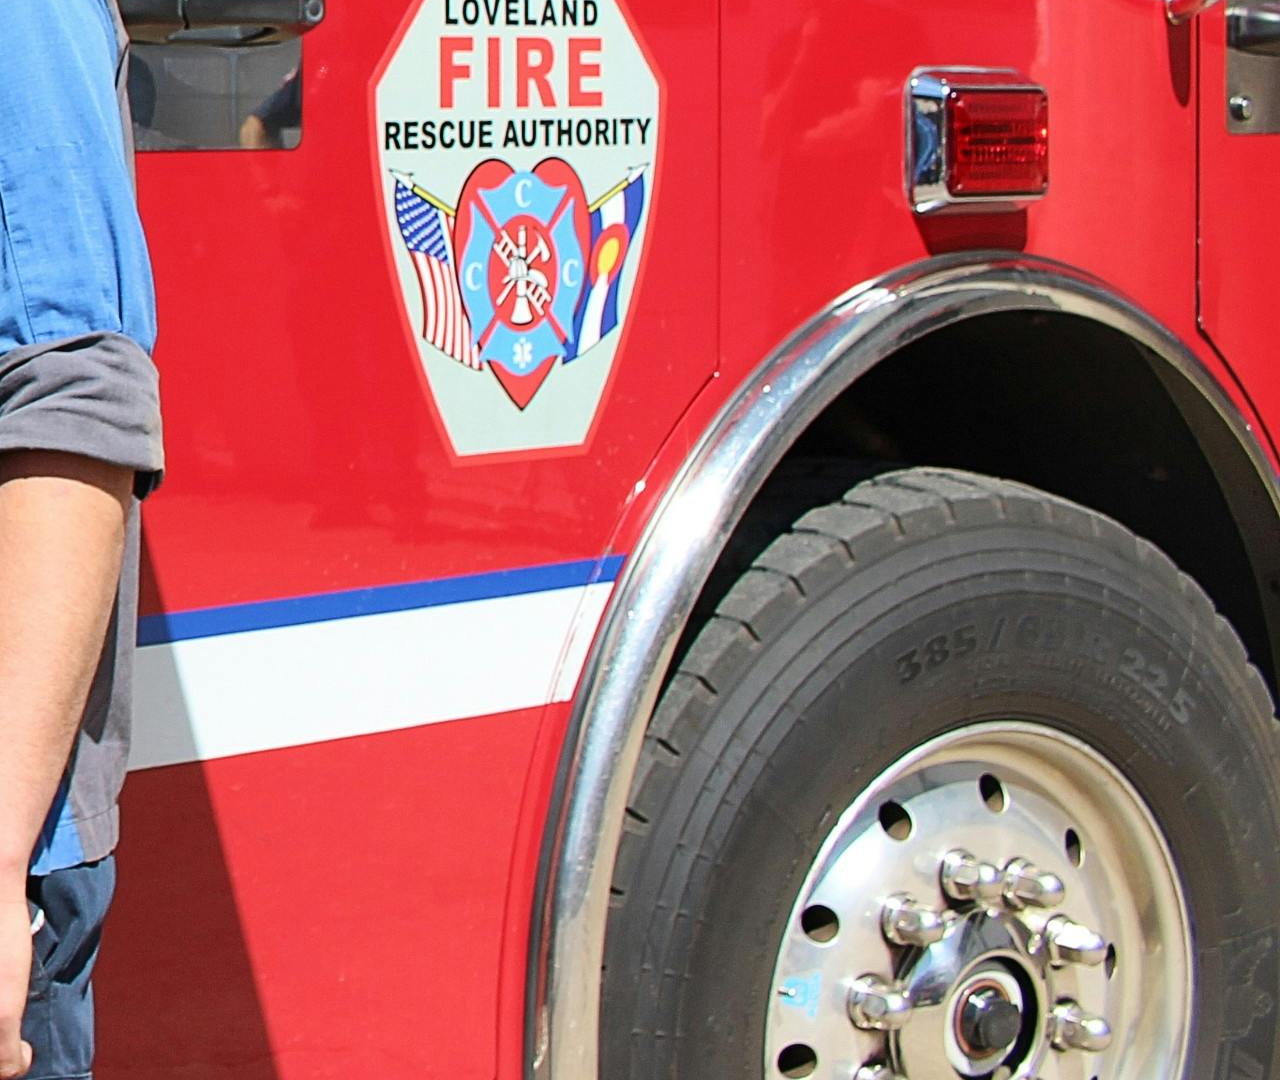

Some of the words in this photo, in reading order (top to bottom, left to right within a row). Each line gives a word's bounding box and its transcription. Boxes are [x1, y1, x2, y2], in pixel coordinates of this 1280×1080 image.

[440, 36, 603, 108] FIRE
[385, 119, 493, 150] RESCUE
[503, 118, 652, 148] AUTHORITY
[515, 179, 532, 208] C
[465, 262, 483, 291] C
[562, 258, 579, 288] C
